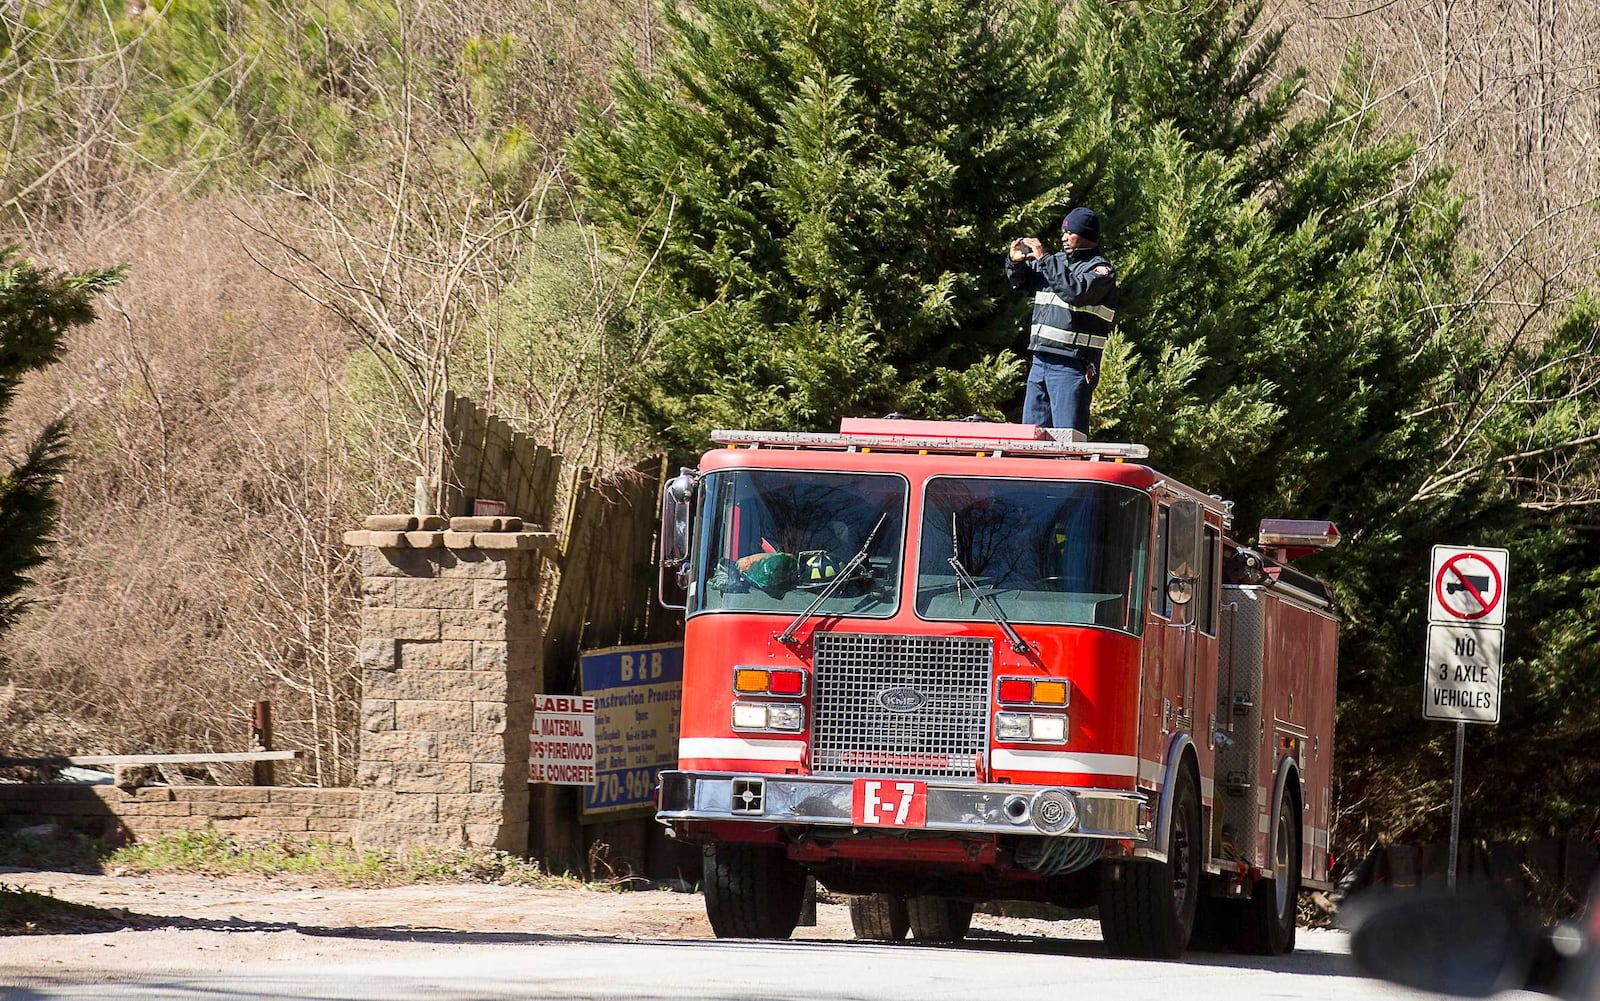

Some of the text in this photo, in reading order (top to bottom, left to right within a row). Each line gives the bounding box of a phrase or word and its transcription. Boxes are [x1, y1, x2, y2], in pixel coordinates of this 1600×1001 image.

[1455, 638, 1475, 657] NO
[621, 652, 662, 681] B & B
[1439, 664, 1489, 683] 3 AXLE
[594, 690, 645, 709] onstruction
[1434, 689, 1491, 708] VEHICLES
[541, 718, 584, 737] MATERIAL
[546, 764, 594, 783] CONCRETE
[863, 781, 915, 825] E-7
